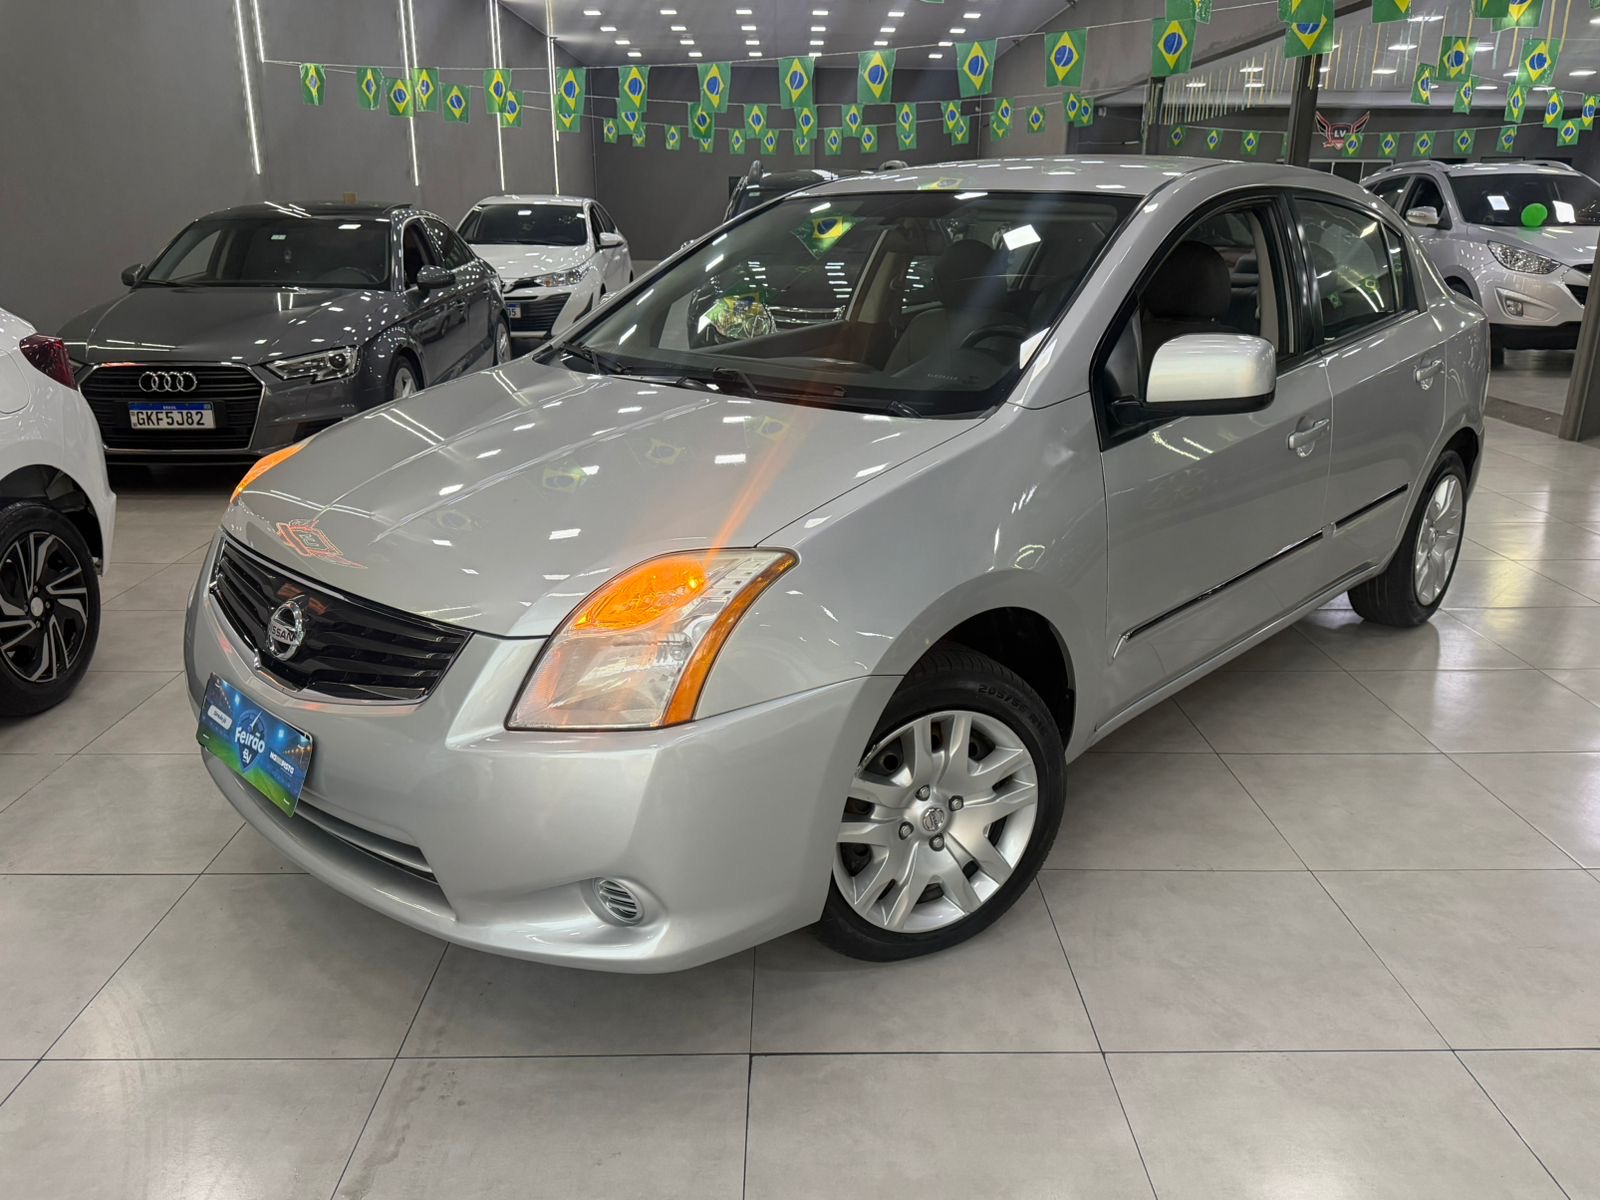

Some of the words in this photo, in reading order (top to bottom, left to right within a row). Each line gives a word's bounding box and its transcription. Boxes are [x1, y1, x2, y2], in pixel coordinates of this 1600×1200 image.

[1334, 130, 1347, 138] LV
[136, 411, 205, 426] GKF5J82
[234, 726, 266, 754] Feirão
